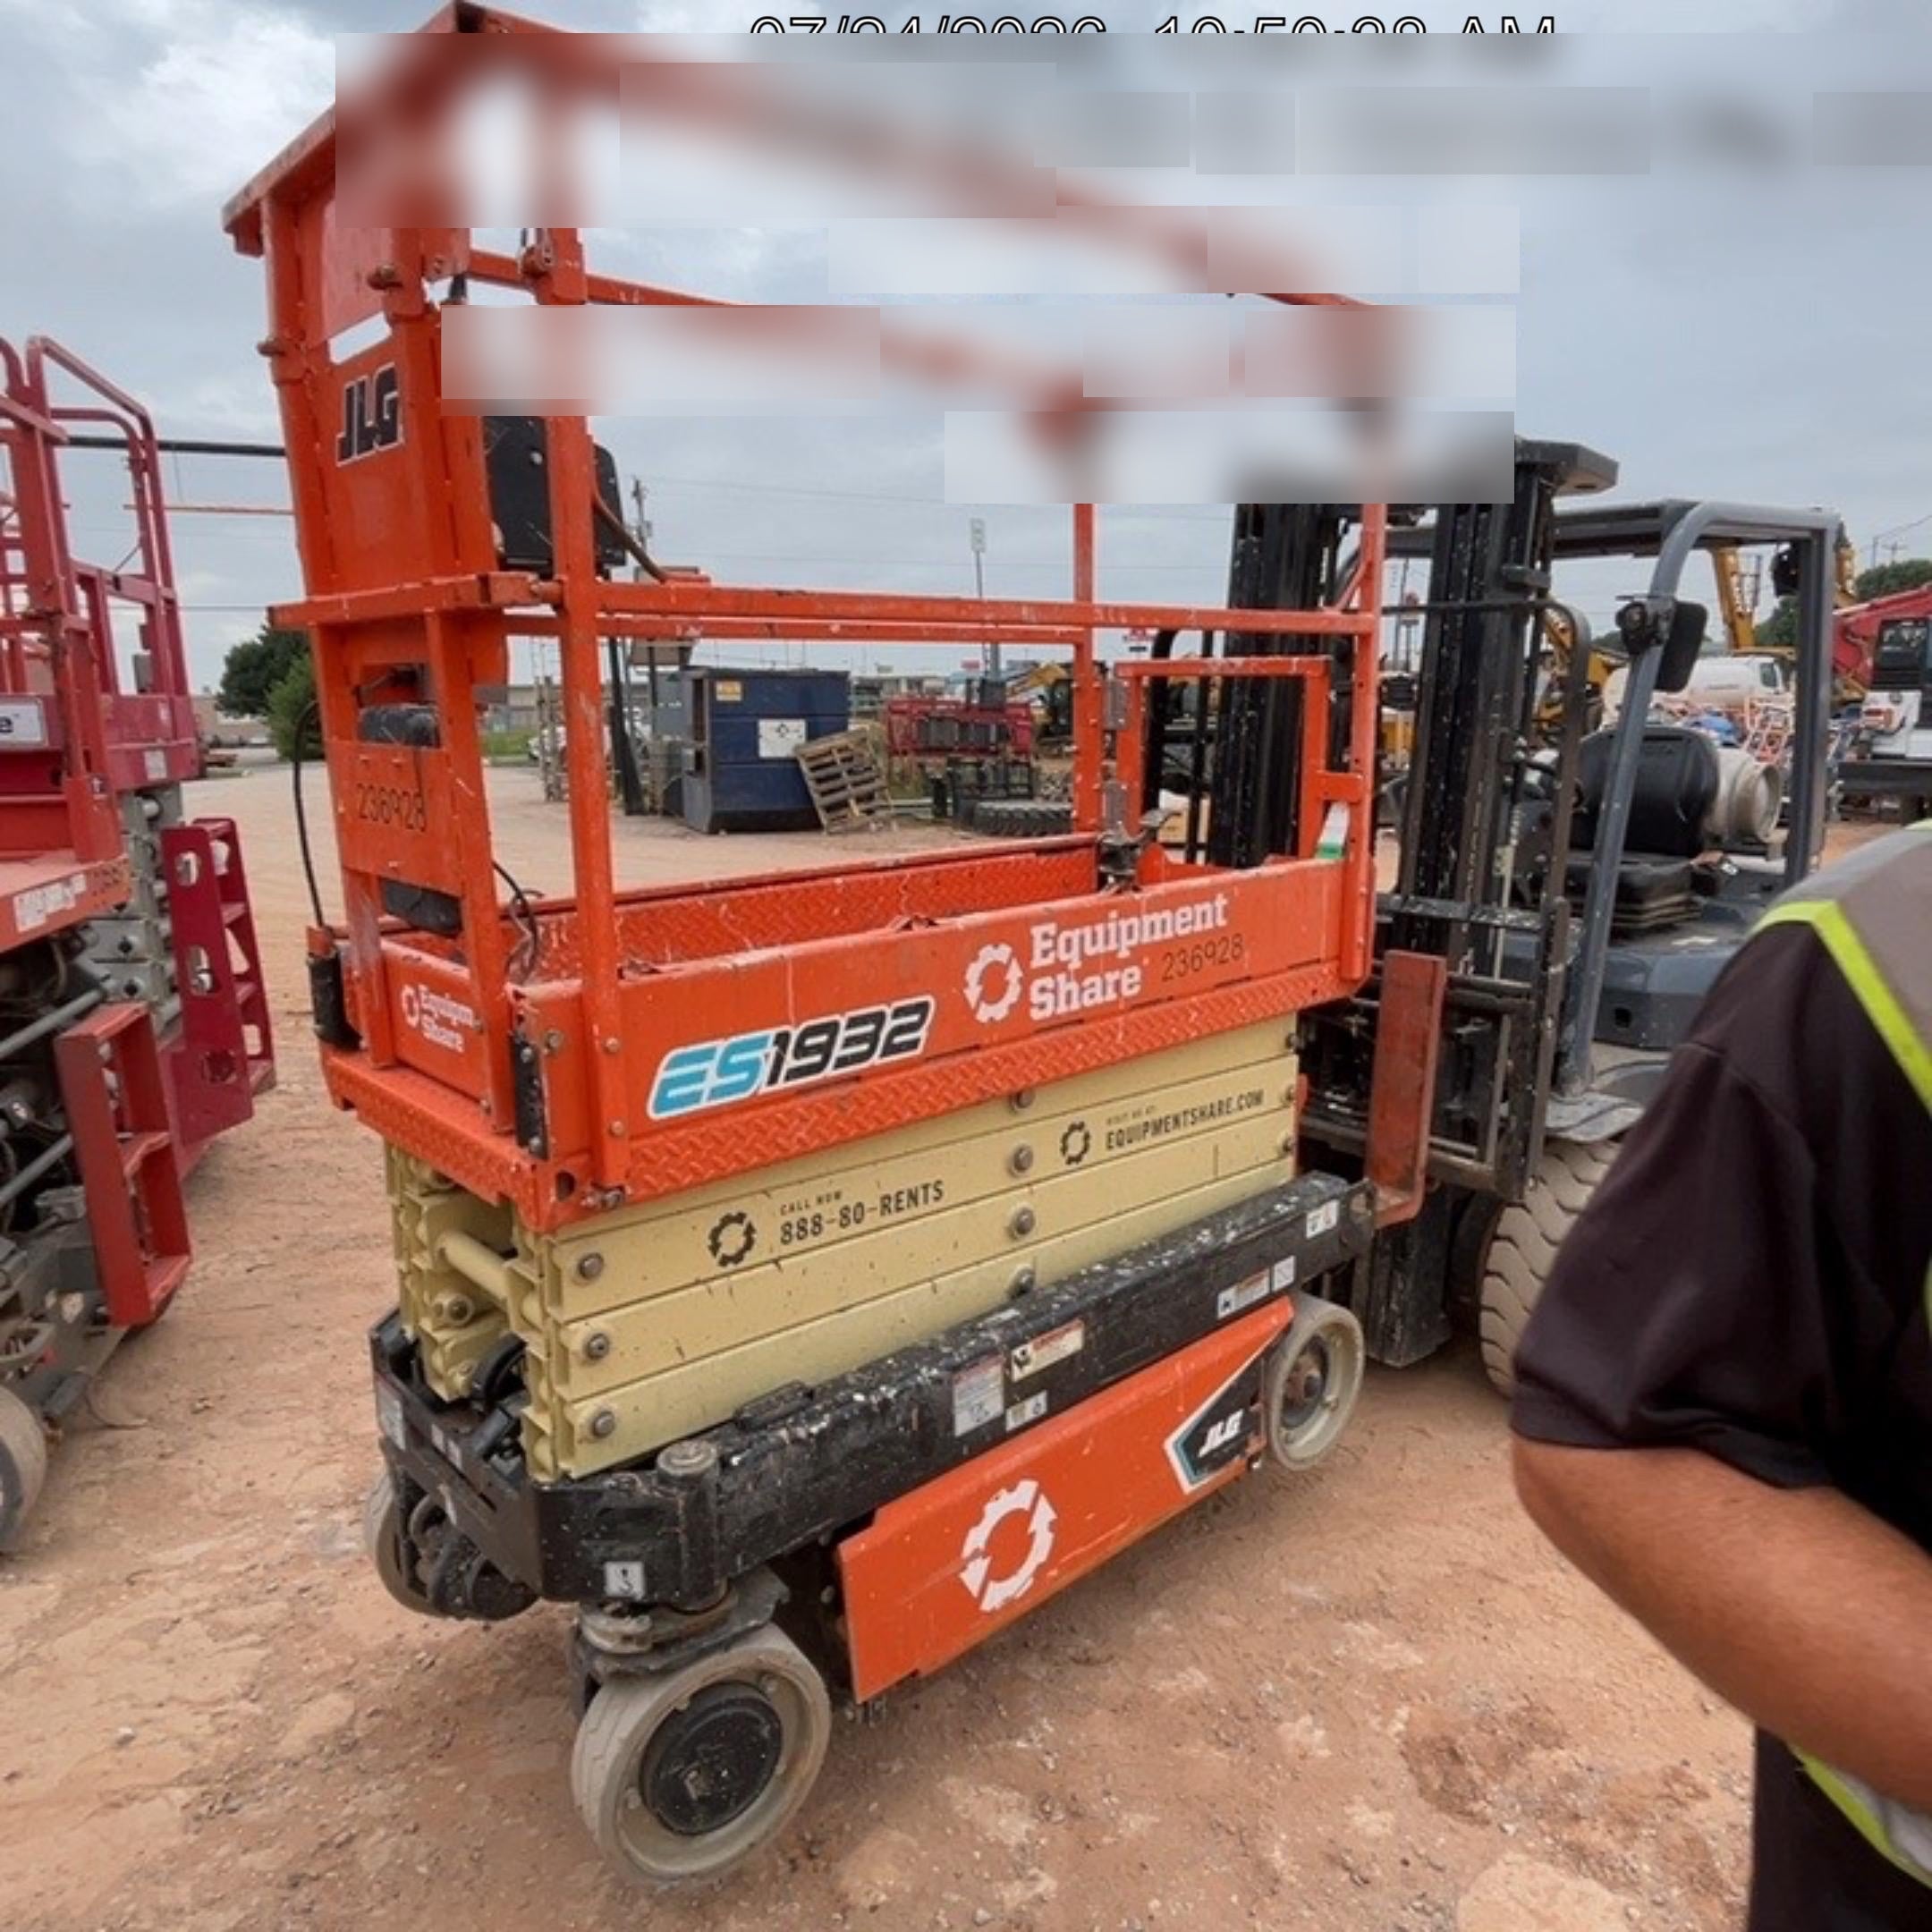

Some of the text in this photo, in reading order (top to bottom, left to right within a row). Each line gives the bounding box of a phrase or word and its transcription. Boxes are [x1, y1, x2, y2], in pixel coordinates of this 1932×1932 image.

[336, 363, 402, 465] JLG
[356, 783, 427, 833] 236928
[1030, 893, 1228, 970] Equipment
[1162, 933, 1244, 982] 236928
[1030, 965, 1141, 1021] Share
[648, 996, 934, 1119] ES1932
[780, 1180, 945, 1245] 888-80-RENTS
[1199, 1409, 1243, 1457] JLG
